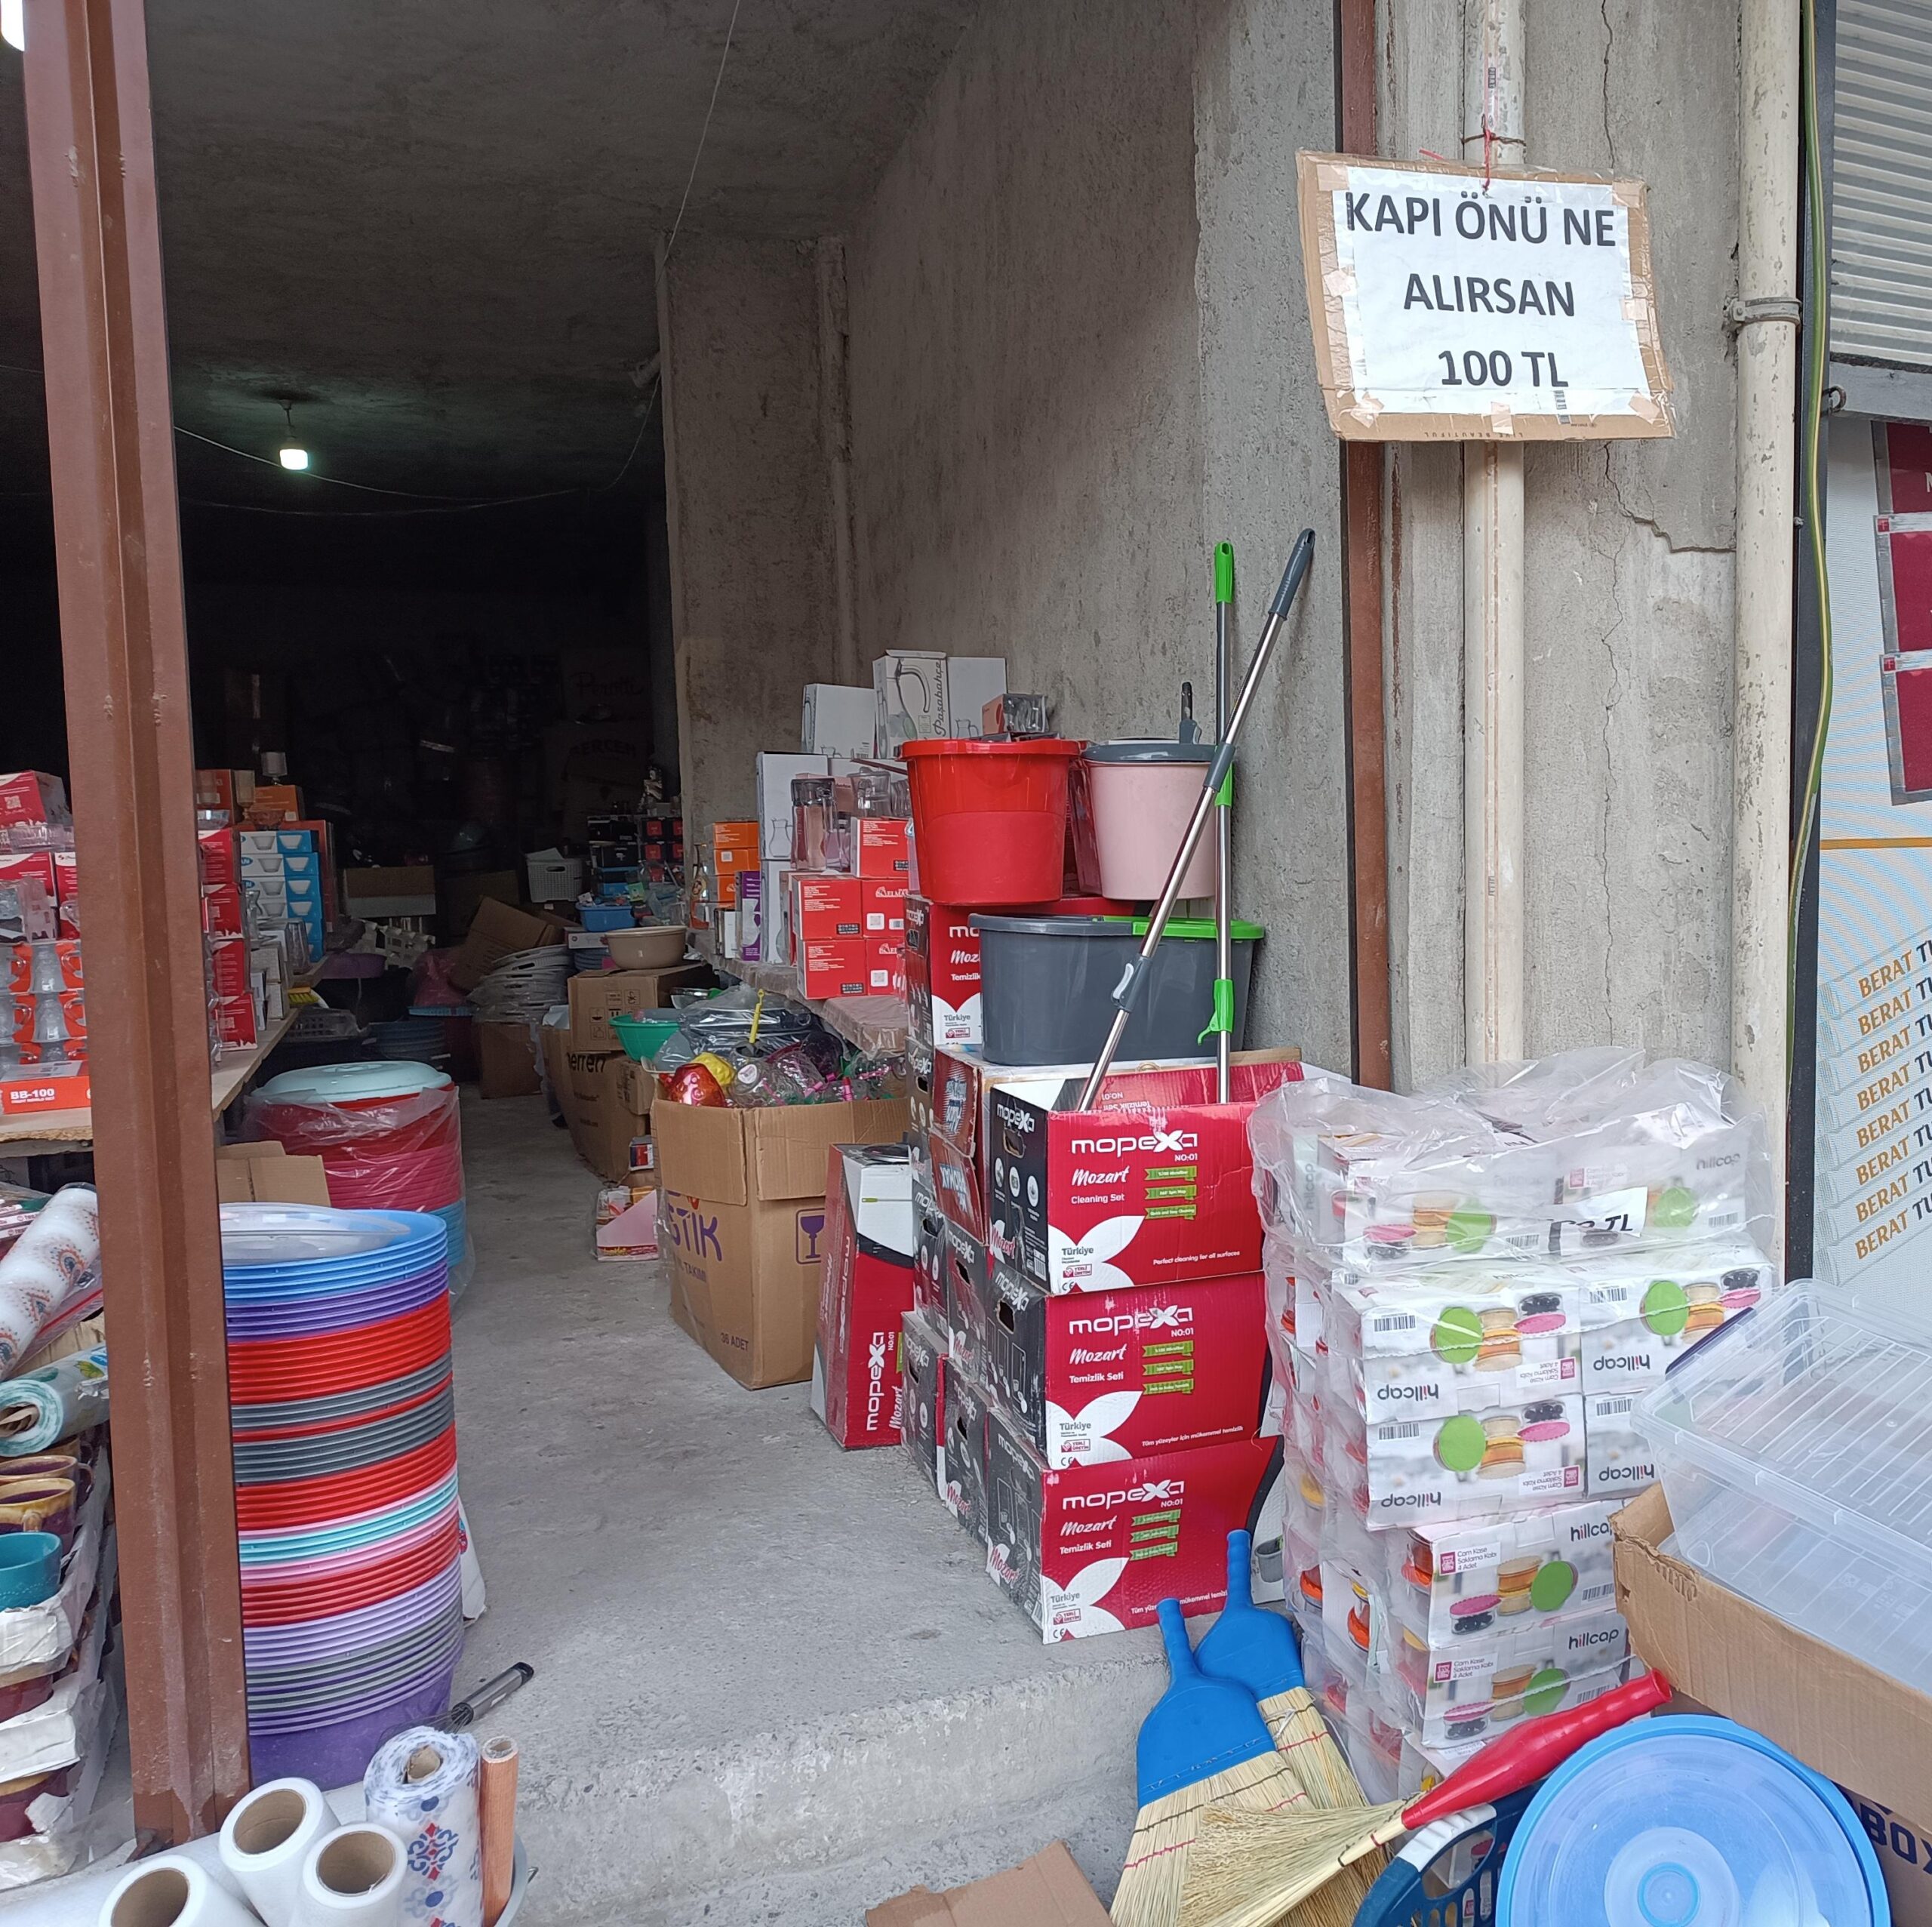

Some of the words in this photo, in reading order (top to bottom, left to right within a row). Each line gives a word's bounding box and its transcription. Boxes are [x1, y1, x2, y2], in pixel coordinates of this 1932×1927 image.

[1346, 192, 1441, 236] KAPI
[1456, 191, 1547, 244] ÖNÜ
[1564, 208, 1616, 247] NE
[1404, 273, 1575, 317] ALIRSAN
[1438, 350, 1512, 387] 100
[1521, 351, 1568, 388] TL
[1859, 950, 1912, 998] BERAT
[1858, 987, 1911, 1036] BERAT
[1857, 1024, 1910, 1073] BERAT
[10, 1088, 55, 1100] BB-100
[1857, 1061, 1909, 1111] BERAT
[1857, 1098, 1909, 1148] BERAT
[1174, 1153, 1198, 1162] NO:01
[1857, 1135, 1909, 1185] BERAT
[1072, 1165, 1130, 1186] Mozart
[1071, 1194, 1108, 1205] Cleaning
[1110, 1193, 1125, 1202] Set
[1856, 1171, 1908, 1222] BERAT
[991, 1224, 1016, 1258] Mozart
[1855, 1208, 1907, 1259] BERAT
[1061, 1246, 1094, 1256] Türkiye
[1174, 1255, 1198, 1264] cleaning
[1217, 1250, 1241, 1259] surfaces
[1171, 1327, 1195, 1338] NO:01
[731, 1335, 749, 1352] ADET
[1069, 1344, 1128, 1365] Mozart
[1593, 1354, 1651, 1371] hillcap
[1069, 1373, 1105, 1384] Temizlik
[1106, 1371, 1124, 1381] Seti
[1377, 1384, 1439, 1402] hillcap
[890, 1386, 904, 1430] Mozart
[1059, 1421, 1091, 1431] Türkiye
[1142, 1439, 1155, 1447] Tüm
[1155, 1435, 1179, 1445] yüzeyler
[1598, 1464, 1654, 1481] hillcap
[1161, 1498, 1183, 1508] NO:01
[1381, 1491, 1441, 1508] hillcap
[1060, 1516, 1118, 1537] Mozart
[1060, 1542, 1094, 1555] Temizlik
[1095, 1539, 1112, 1550] Seti
[990, 1547, 1020, 1583] Mozart
[1051, 1593, 1080, 1603] Türkiye
[1131, 1606, 1143, 1615] Tüm
[1211, 1590, 1227, 1599] temizl
[1568, 1629, 1619, 1650] hillcap
